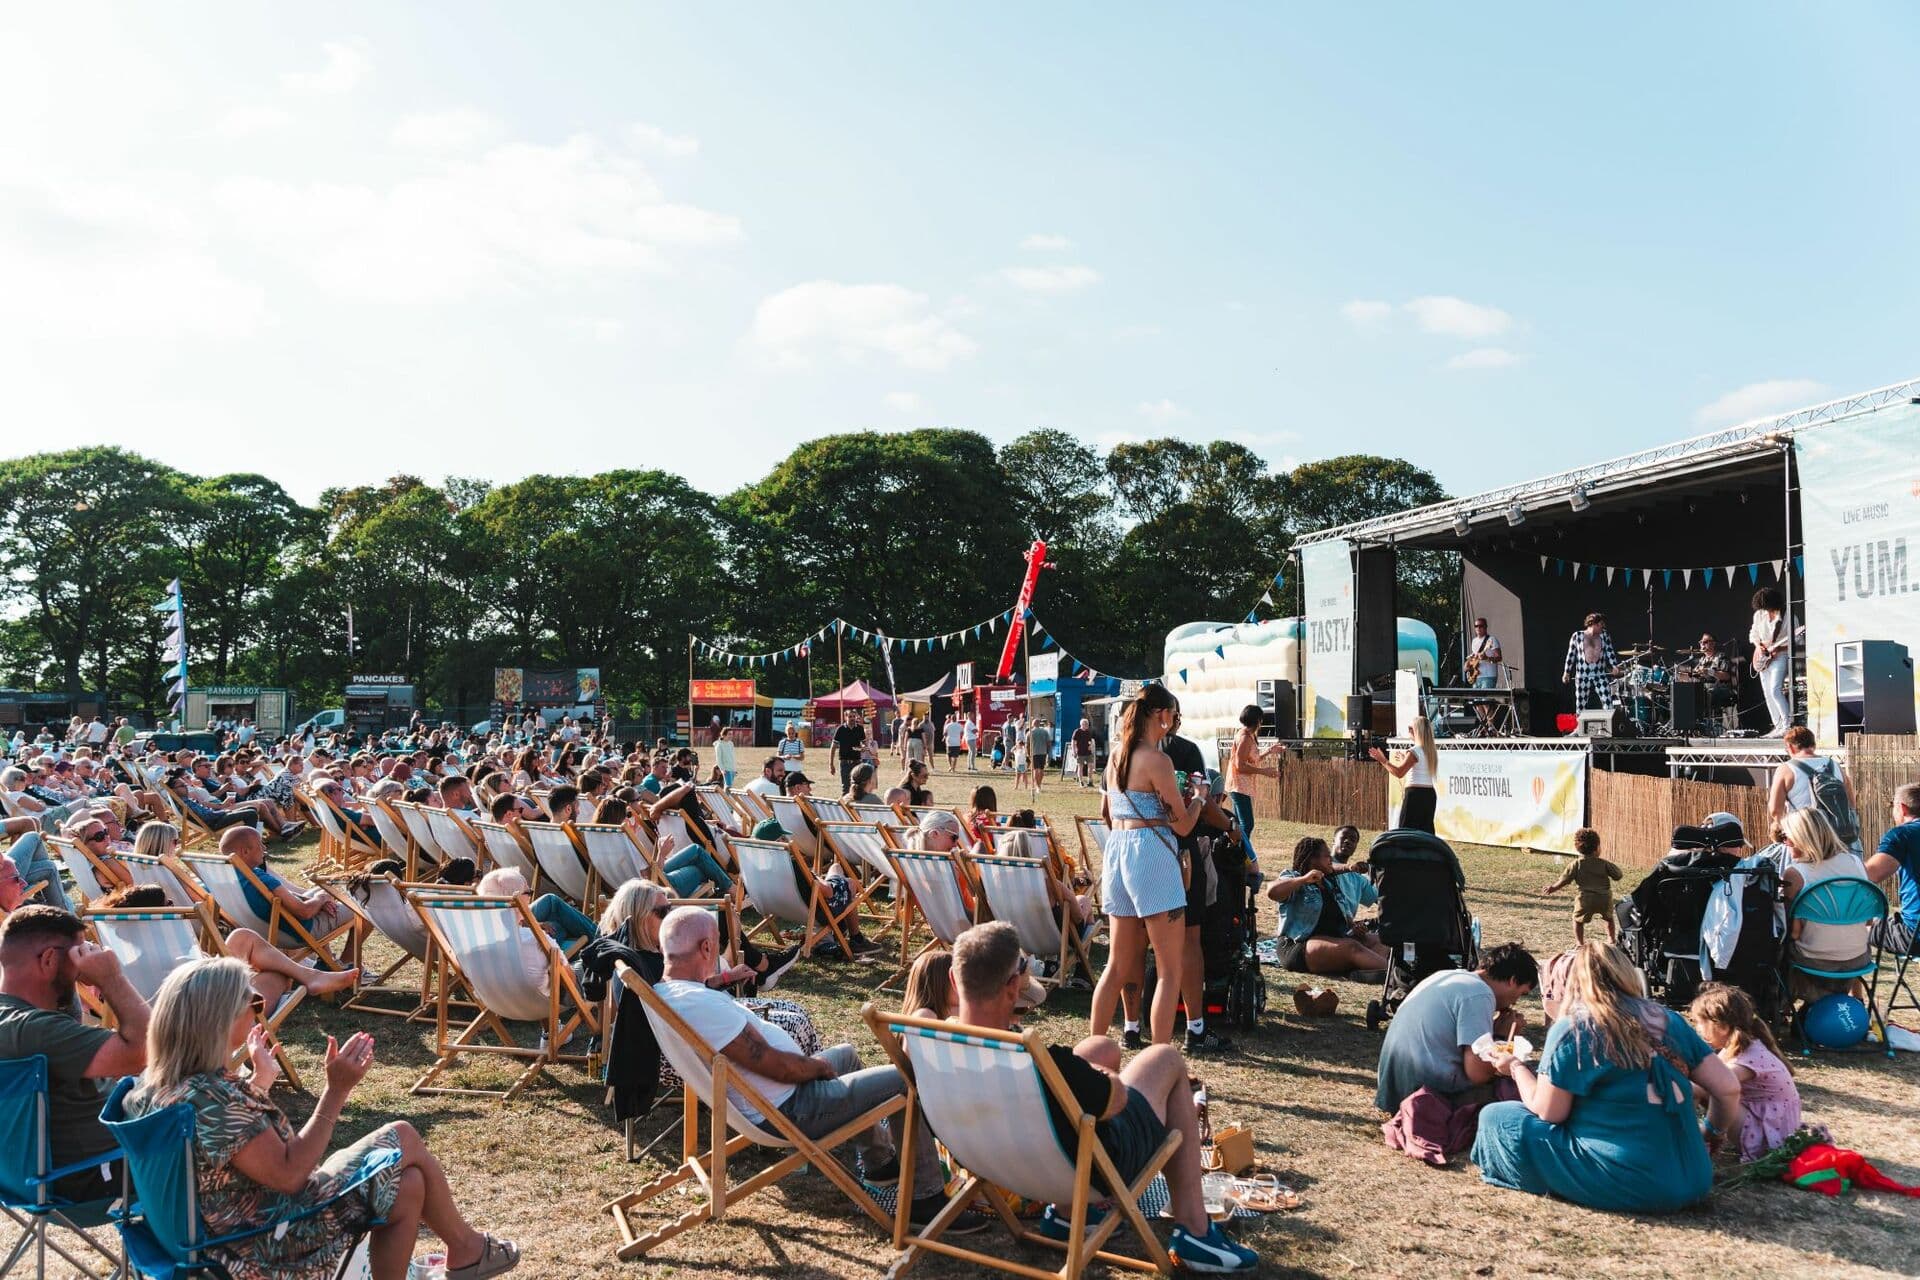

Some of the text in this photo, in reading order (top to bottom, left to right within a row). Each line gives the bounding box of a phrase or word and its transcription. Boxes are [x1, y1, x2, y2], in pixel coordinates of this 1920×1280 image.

[1843, 503, 1889, 524] LIVE MUSIC
[1830, 537, 1920, 601] YUM.
[1310, 617, 1350, 654] TASTY.
[352, 675, 405, 683] PANCAKES
[207, 687, 260, 695] BAMBOO BOX
[1449, 775, 1513, 798] FOOD FESTIVAL
